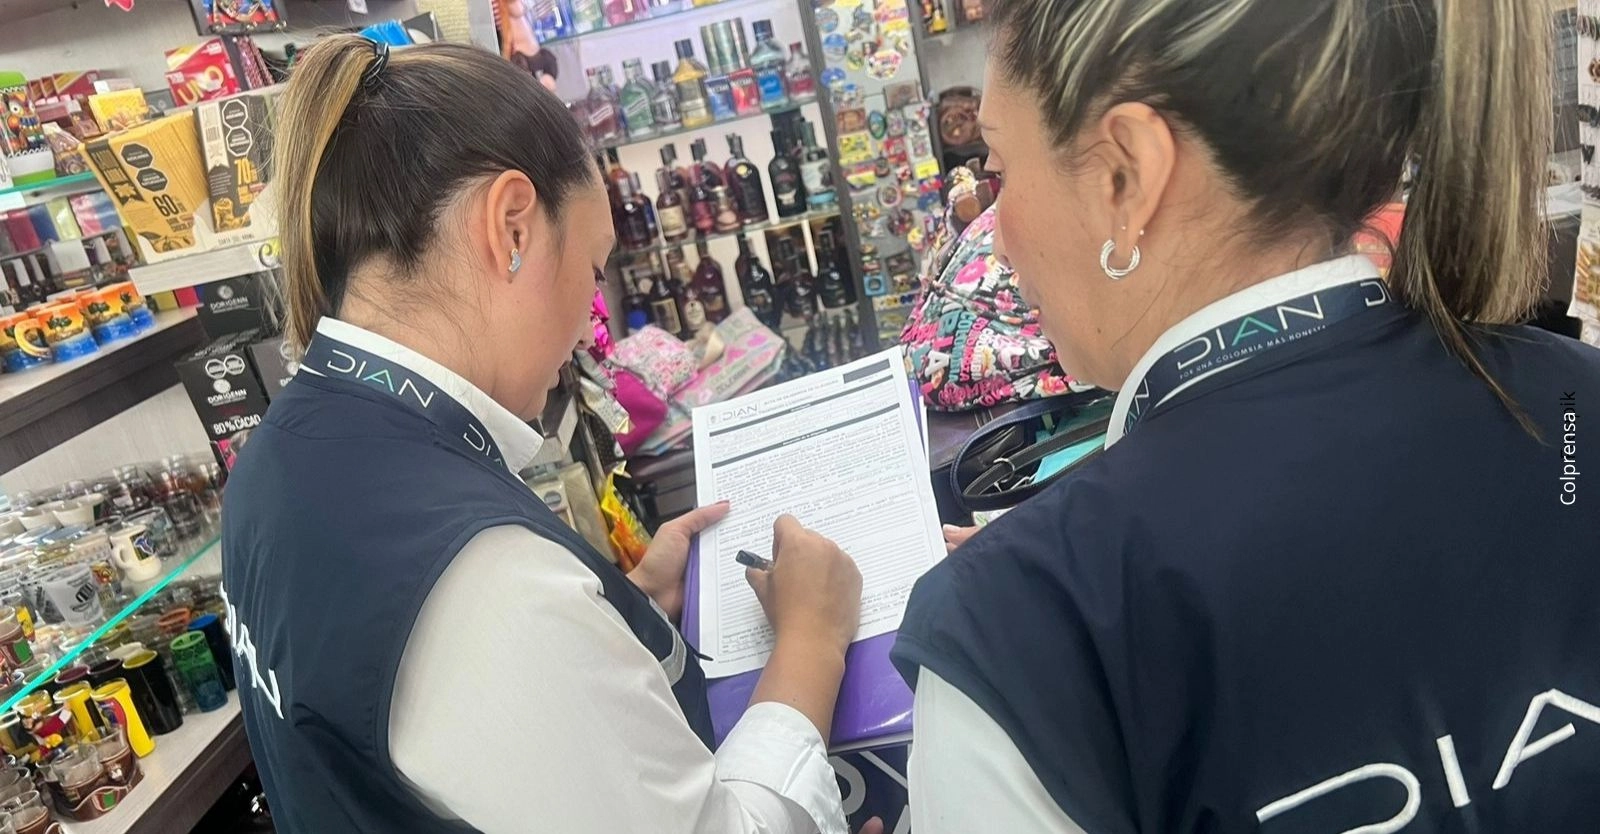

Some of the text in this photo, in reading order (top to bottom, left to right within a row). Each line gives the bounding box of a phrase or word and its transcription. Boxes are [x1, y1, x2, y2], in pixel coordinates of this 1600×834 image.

[153, 193, 179, 217] 60
[1173, 295, 1325, 370] DIAN
[1215, 344, 1263, 363] COLOMBIA
[327, 349, 434, 408] DIAN
[234, 414, 261, 430] CACAO
[722, 403, 758, 421] DIAN
